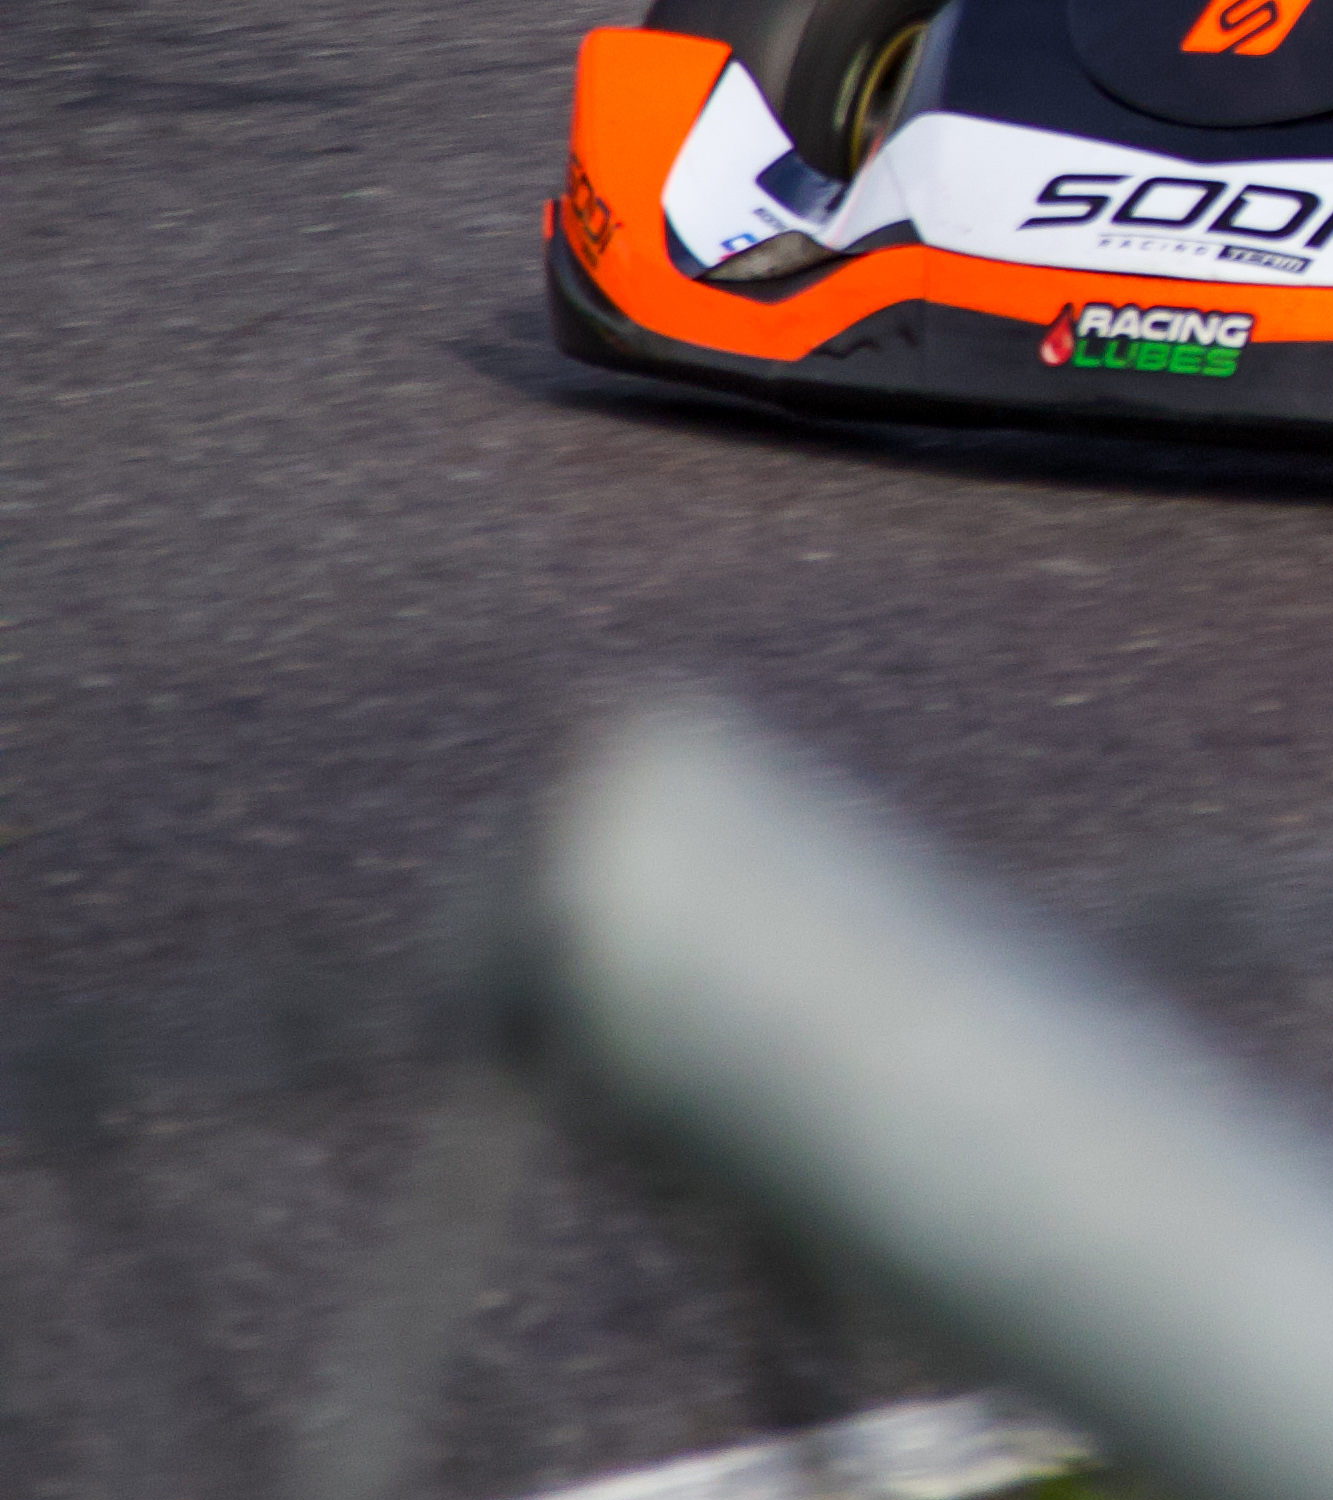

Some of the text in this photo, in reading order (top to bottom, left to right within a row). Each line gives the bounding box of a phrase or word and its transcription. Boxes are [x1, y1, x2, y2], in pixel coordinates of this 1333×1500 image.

[1099, 237, 1308, 274] RACING TEAM
[1078, 305, 1255, 348] RACING
[1072, 339, 1242, 378] LUBES
